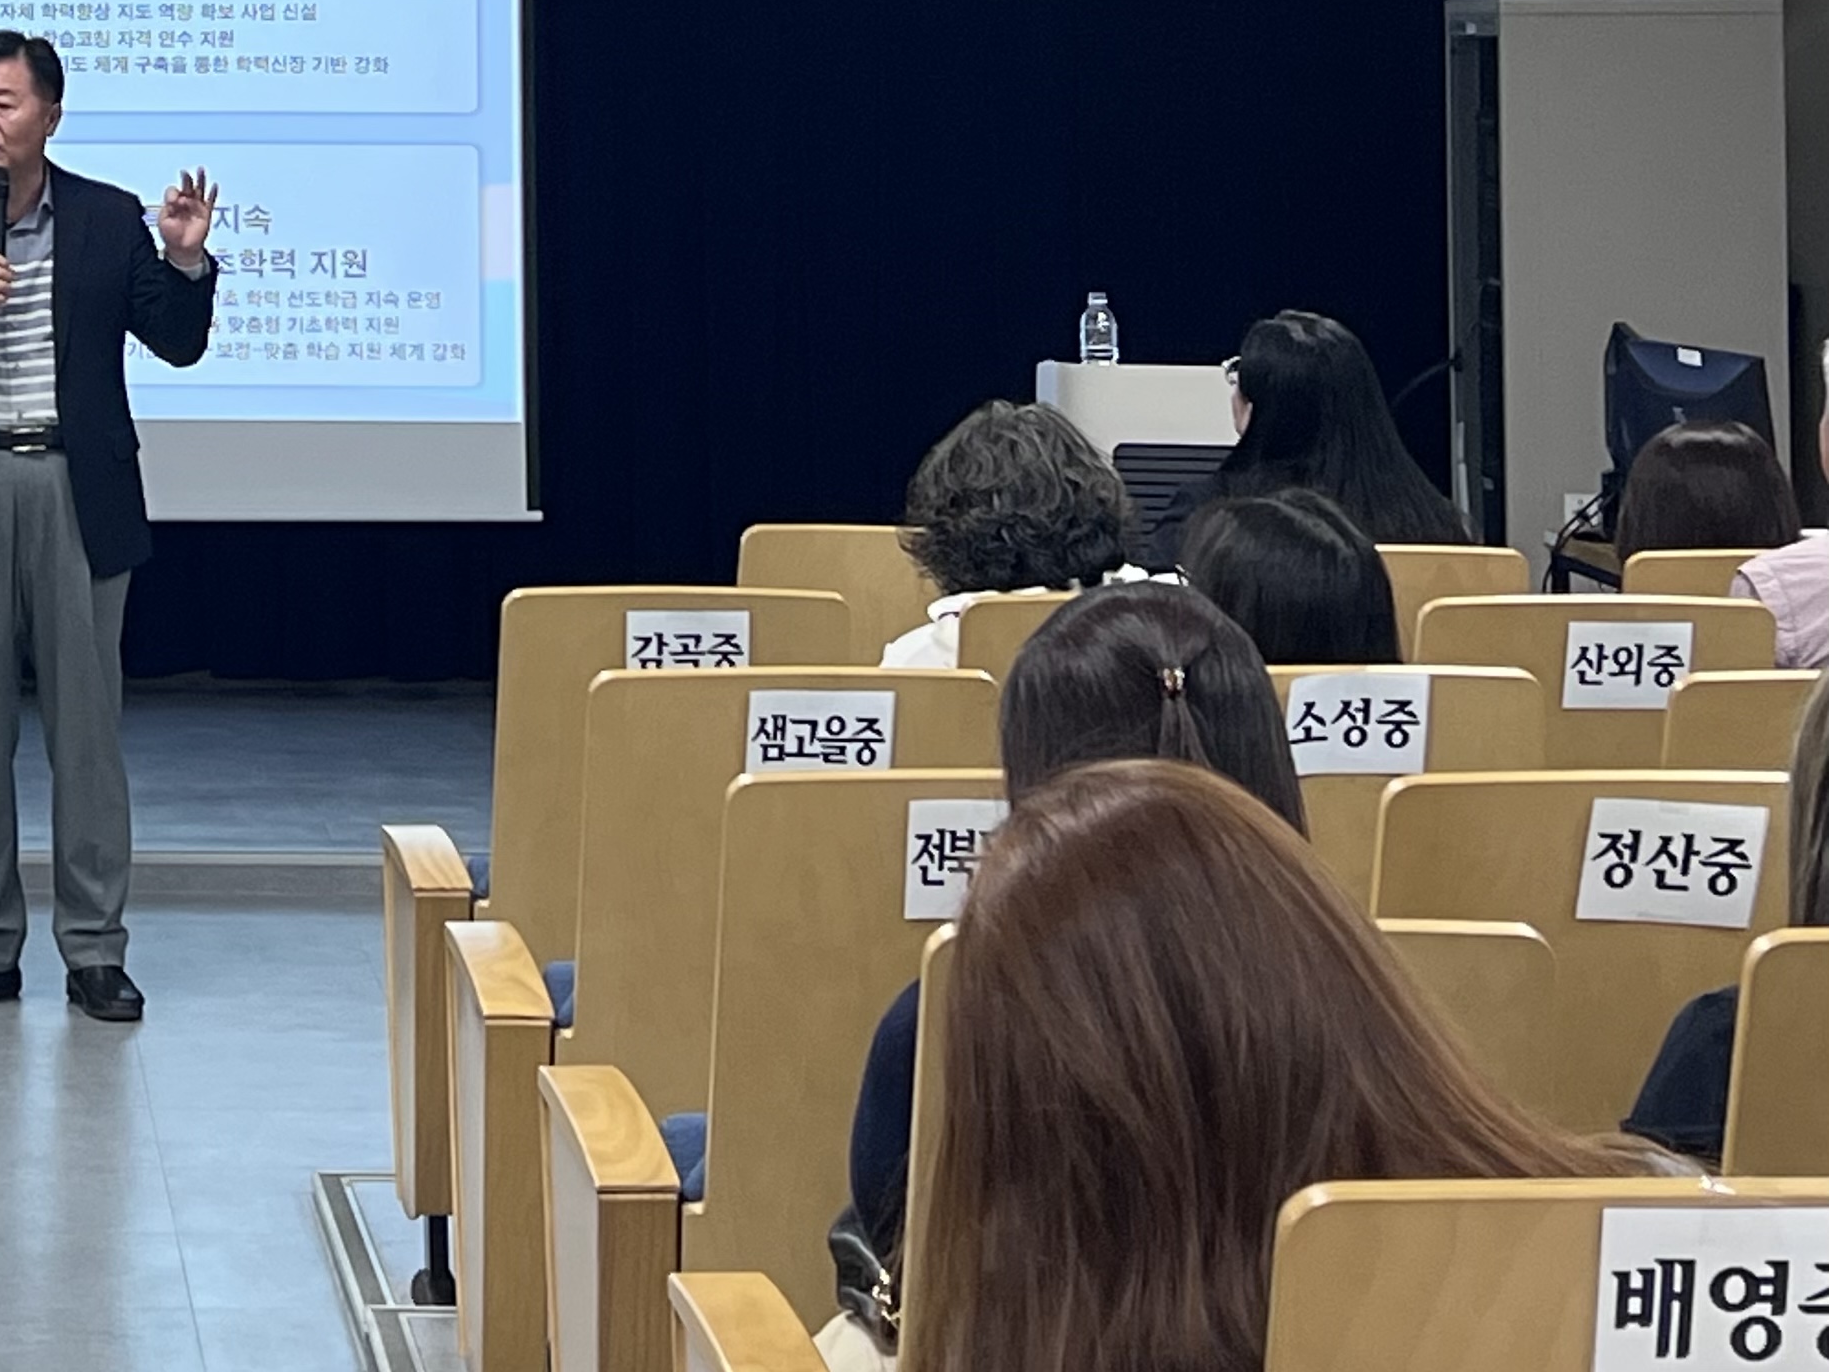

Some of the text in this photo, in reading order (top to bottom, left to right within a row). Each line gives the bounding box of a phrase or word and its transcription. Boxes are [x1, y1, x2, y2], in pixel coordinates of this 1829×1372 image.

[0, 3, 34, 21] 자체
[41, 3, 110, 21] 학력향상
[117, 3, 153, 21] 지도
[158, 3, 193, 21] 역량
[201, 3, 235, 21] 확보
[241, 3, 275, 21] 사업
[283, 3, 317, 21] 신설
[118, 29, 152, 48] 자격
[158, 29, 193, 48] 연수
[200, 29, 234, 48] 지원
[236, 56, 306, 74] 학력신장
[312, 56, 347, 74] 기반
[355, 56, 390, 74] 강화
[309, 247, 368, 278] 지원
[365, 290, 399, 309] 지속
[287, 315, 358, 334] 기초학력
[365, 315, 399, 334] 지원
[347, 341, 381, 360] 지원
[1571, 642, 1685, 688] 산외중
[1290, 697, 1420, 749] 소성중
[751, 714, 886, 767] 샘고을중
[912, 828, 995, 887] 전북
[1591, 829, 1752, 898] 정산중
